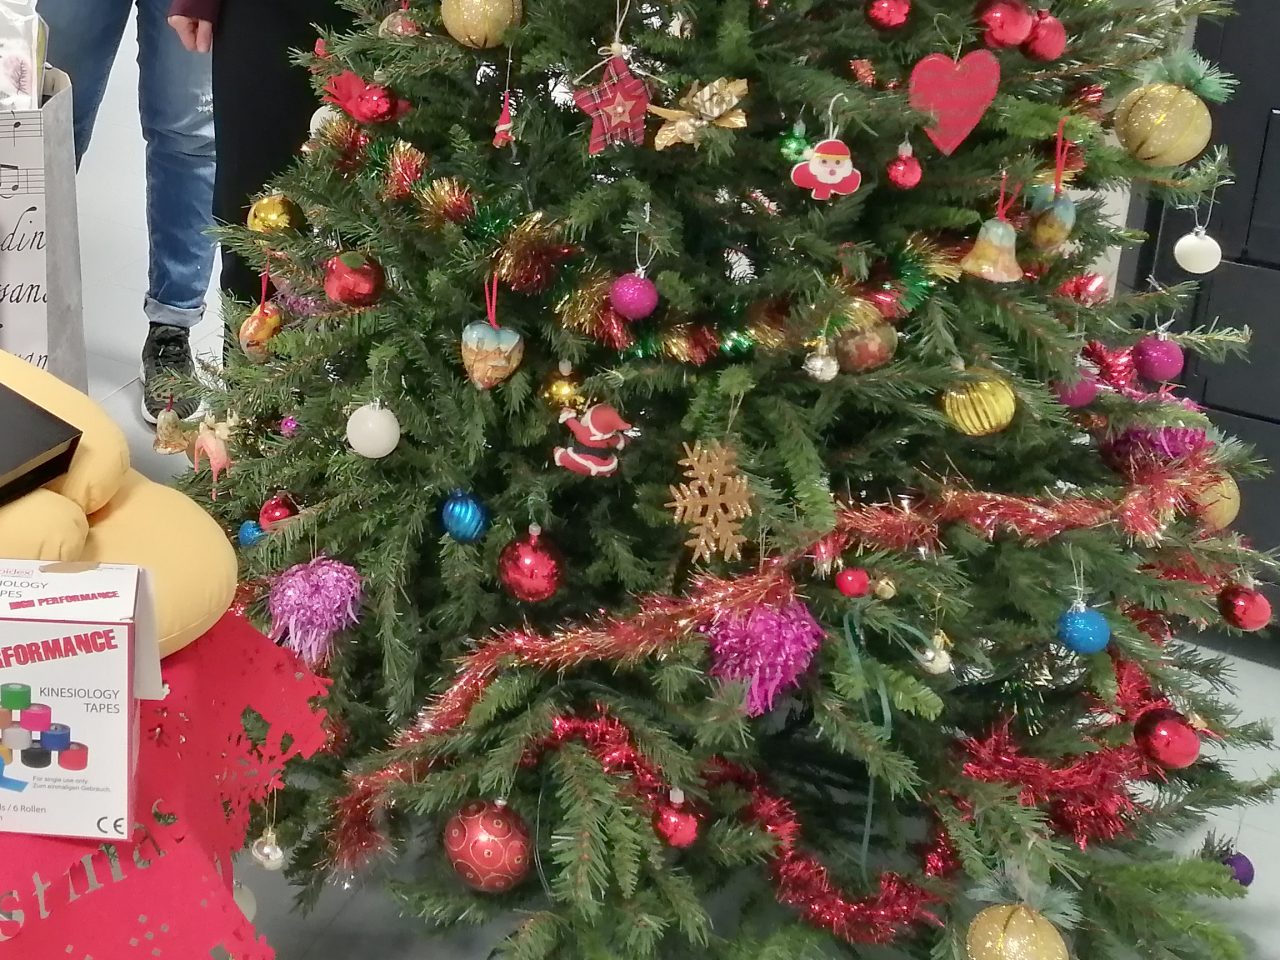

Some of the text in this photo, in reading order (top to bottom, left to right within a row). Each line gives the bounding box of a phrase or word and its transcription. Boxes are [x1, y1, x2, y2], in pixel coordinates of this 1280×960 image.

[38, 591, 120, 607] PERFORMANCE
[39, 687, 120, 700] KINESIOLOGY
[84, 703, 120, 714] TAPES
[13, 804, 19, 812] 6
[20, 804, 47, 813] Rollen
